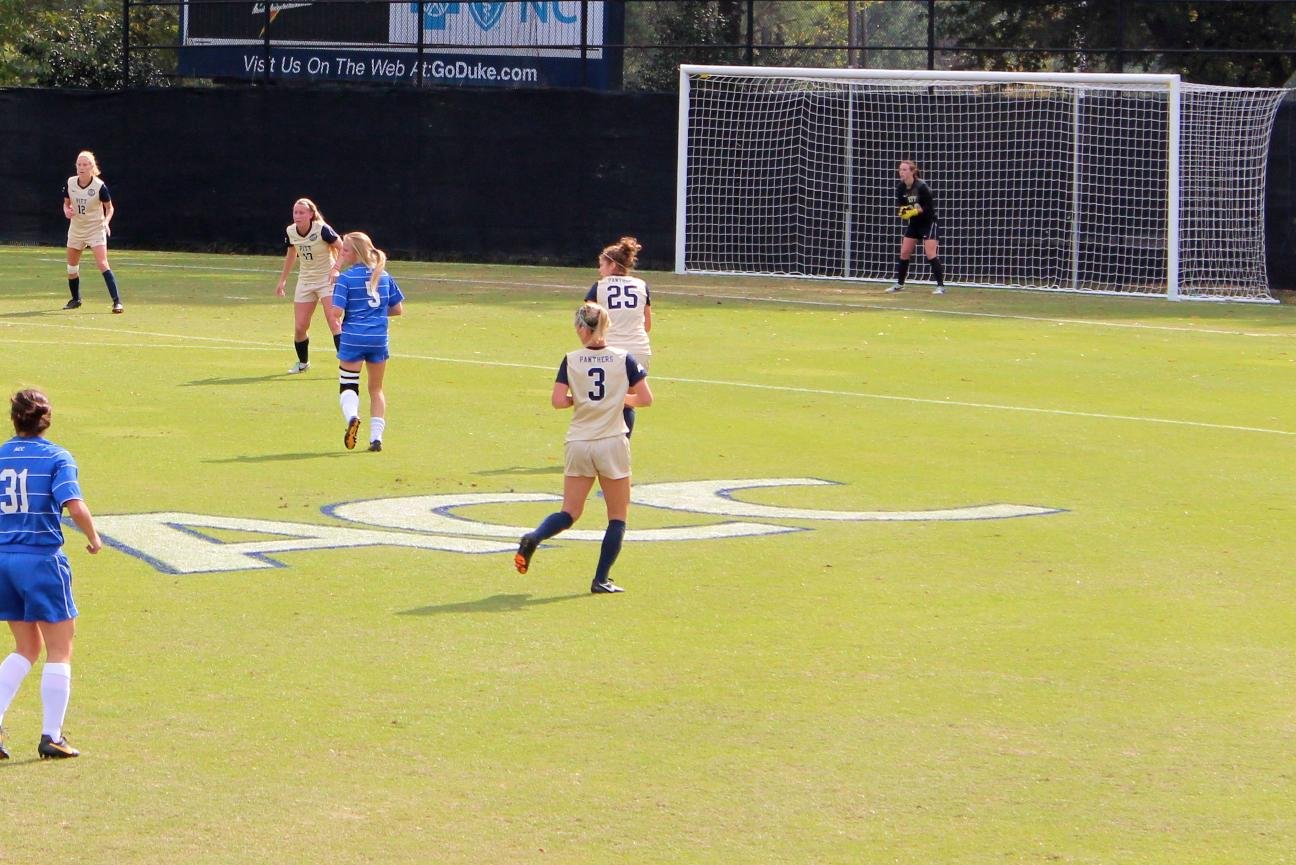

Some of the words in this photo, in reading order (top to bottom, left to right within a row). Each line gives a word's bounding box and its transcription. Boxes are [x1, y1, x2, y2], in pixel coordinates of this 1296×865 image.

[244, 55, 276, 73] Vist
[281, 56, 302, 74] Us
[307, 57, 330, 74] On
[336, 57, 366, 76] The
[371, 58, 405, 77] Web
[78, 204, 86, 215] 12
[607, 285, 638, 310] 25
[579, 355, 614, 363] PANTHERS
[587, 367, 605, 401] 3
[0, 468, 29, 514] 31
[61, 476, 1071, 575] ACC
